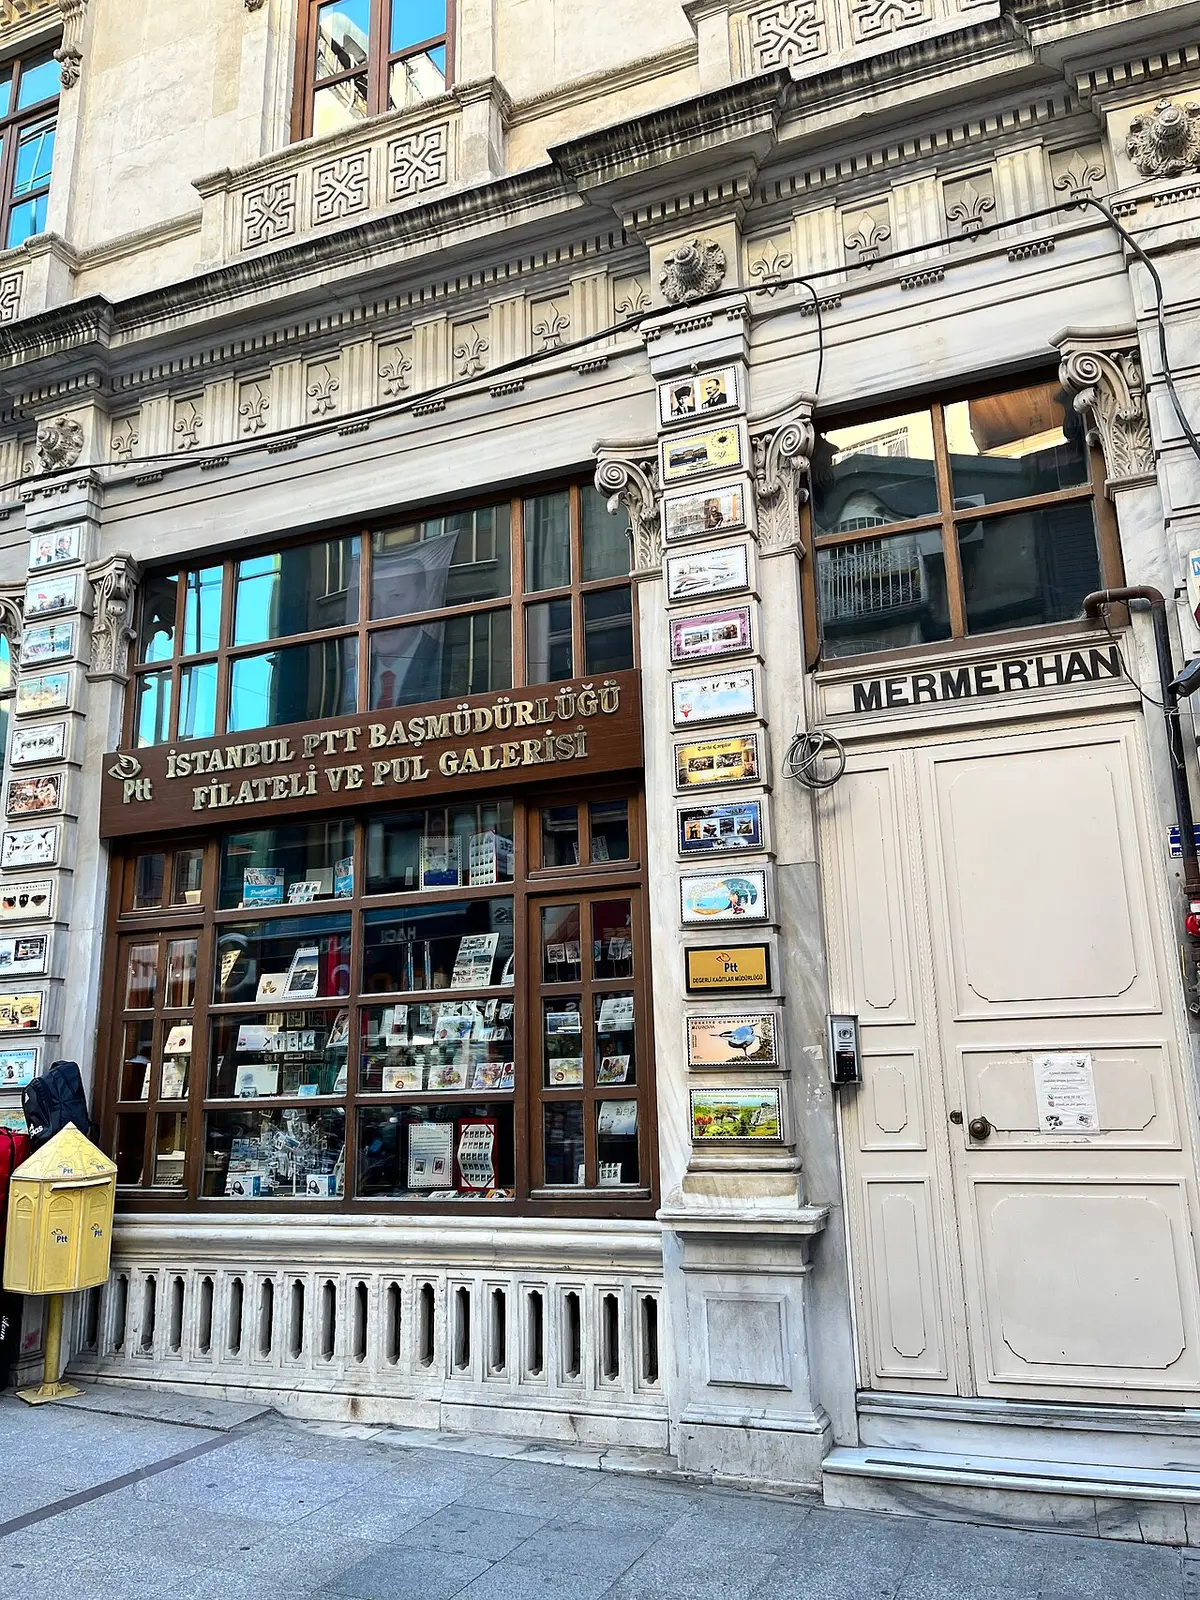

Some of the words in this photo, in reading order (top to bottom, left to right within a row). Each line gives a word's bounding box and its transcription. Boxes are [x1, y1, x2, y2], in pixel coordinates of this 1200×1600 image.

[165, 738, 297, 779] İSTANBUL
[301, 726, 362, 759] PTT
[368, 679, 621, 749] BAŞMÜDÜRLÜĞÜ
[191, 764, 319, 811] FİLATELİ
[325, 764, 364, 793] VE
[371, 755, 433, 786] PUL
[439, 724, 588, 776] GALERİSİ
[122, 777, 153, 804] Ptt
[724, 962, 738, 973] Ptt
[56, 1235, 68, 1243] Ptt
[94, 1229, 103, 1237] Ptt
